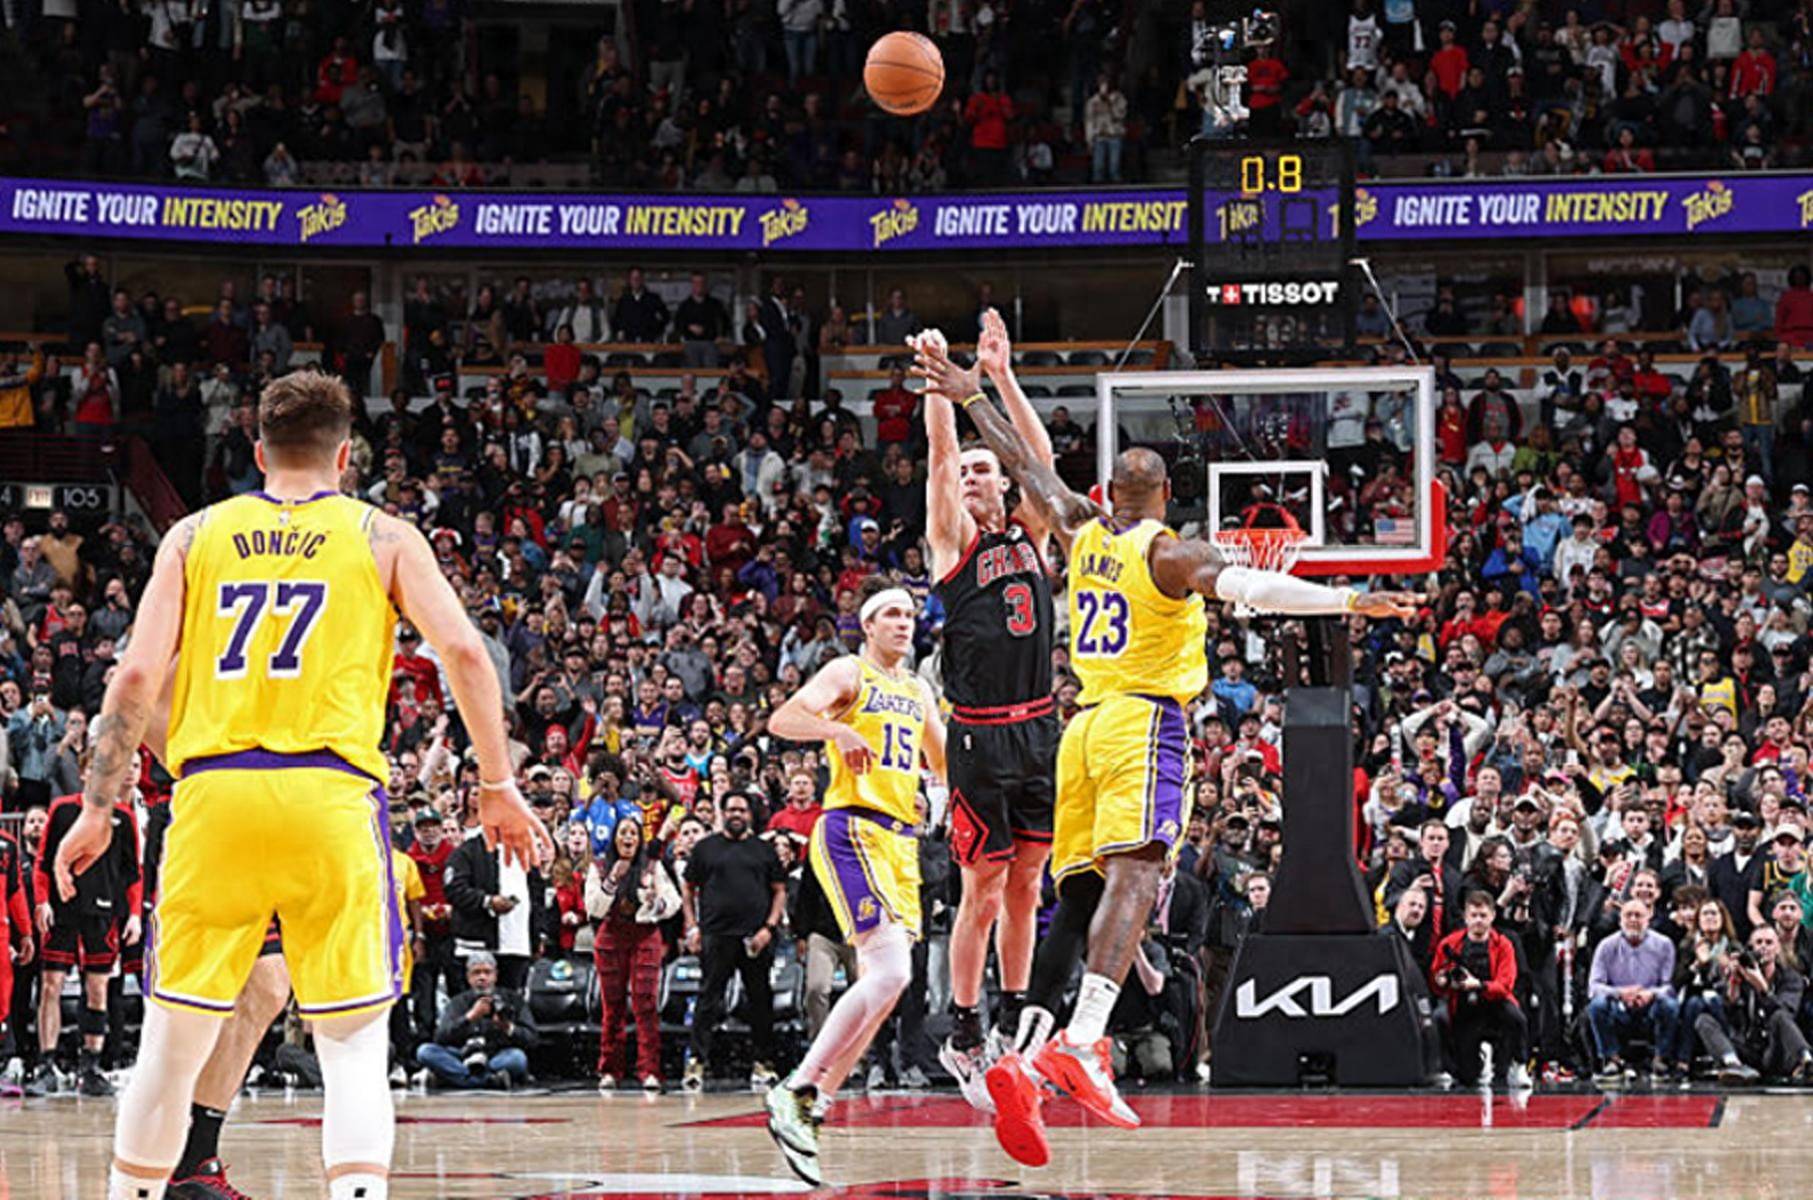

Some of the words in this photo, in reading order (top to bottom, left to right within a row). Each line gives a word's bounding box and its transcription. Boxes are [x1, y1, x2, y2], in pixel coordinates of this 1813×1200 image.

[1241, 154, 1302, 193] 0.8
[12, 188, 90, 222] IGNITE
[96, 193, 159, 226] YOUR
[162, 197, 283, 231] INTENSITY
[296, 202, 347, 243] Takis
[408, 203, 459, 245] Takis
[475, 204, 554, 234] IGNITE
[558, 204, 621, 235] YOUR
[624, 206, 746, 236] INTENSITY
[758, 206, 808, 248] Takis
[869, 206, 918, 248] Takis
[934, 204, 1011, 236] IGNITE
[1016, 203, 1078, 234] YOUR
[1081, 201, 1188, 232] INTENSIT
[1393, 194, 1472, 226] IGNITE
[1478, 193, 1541, 225] YOUR
[1545, 191, 1669, 223] INTENSITY
[1681, 187, 1733, 231] Takis
[1241, 281, 1339, 305] TISSOT
[63, 487, 100, 509] 105
[216, 581, 328, 678] 77
[1004, 582, 1036, 637] 3
[1075, 590, 1131, 657] 23
[881, 722, 913, 770] 15
[1236, 974, 1399, 1018] KIA
